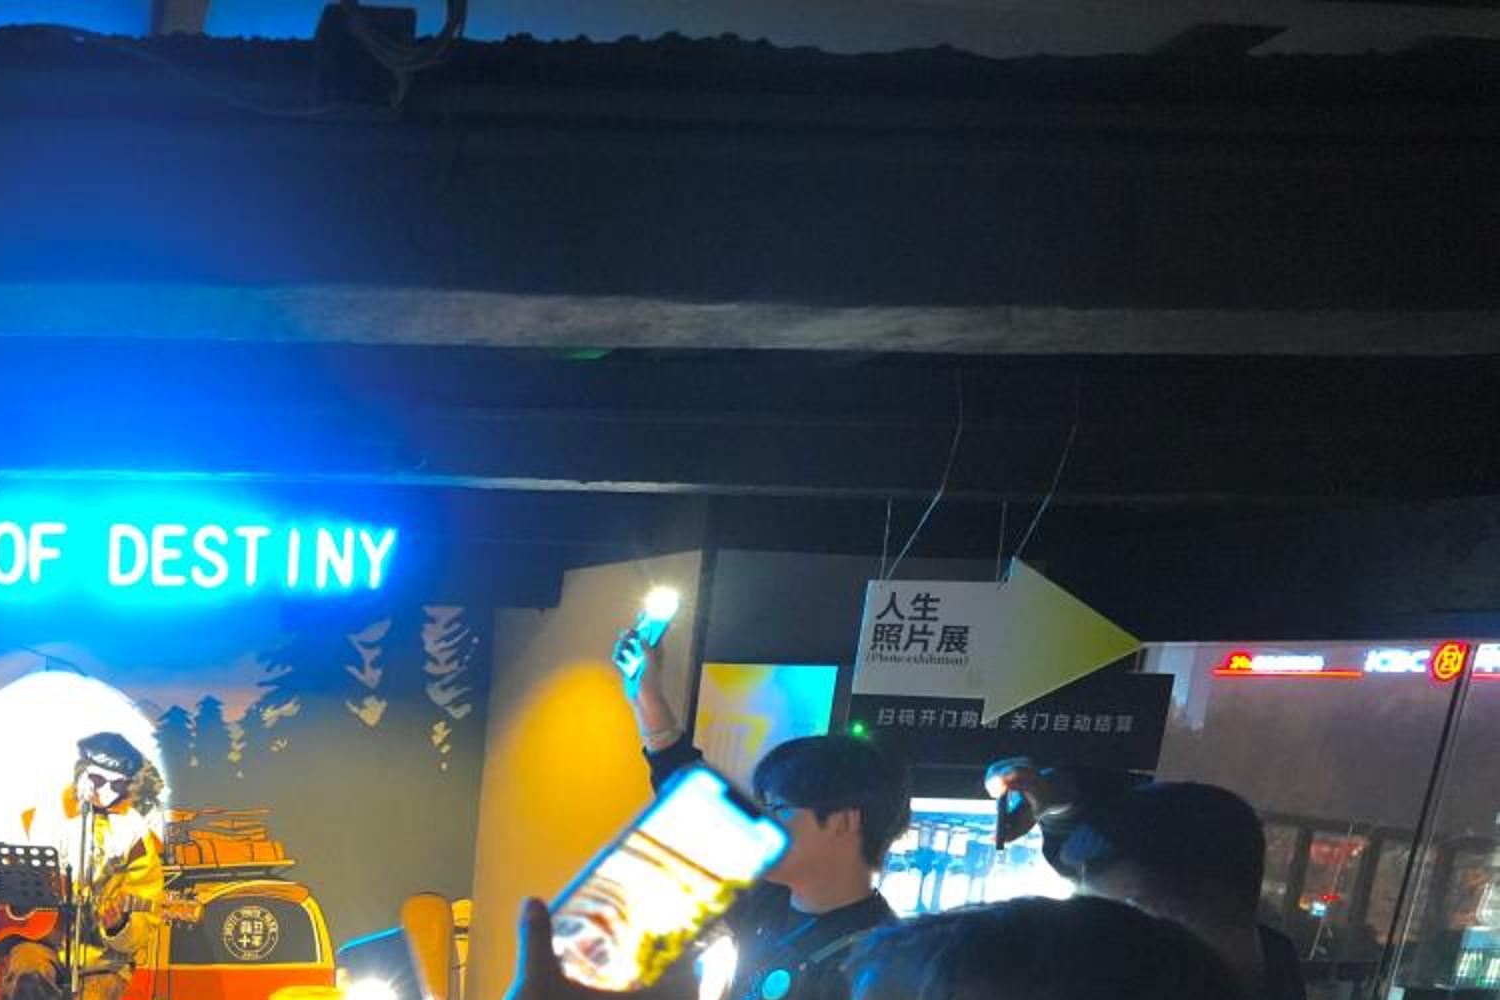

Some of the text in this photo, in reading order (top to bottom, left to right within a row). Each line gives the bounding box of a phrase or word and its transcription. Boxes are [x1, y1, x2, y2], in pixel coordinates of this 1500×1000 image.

[108, 523, 397, 589] DESTINY
[876, 591, 941, 622] 人生
[869, 622, 970, 654] 照片展
[1011, 711, 1133, 735] 关门自动结算
